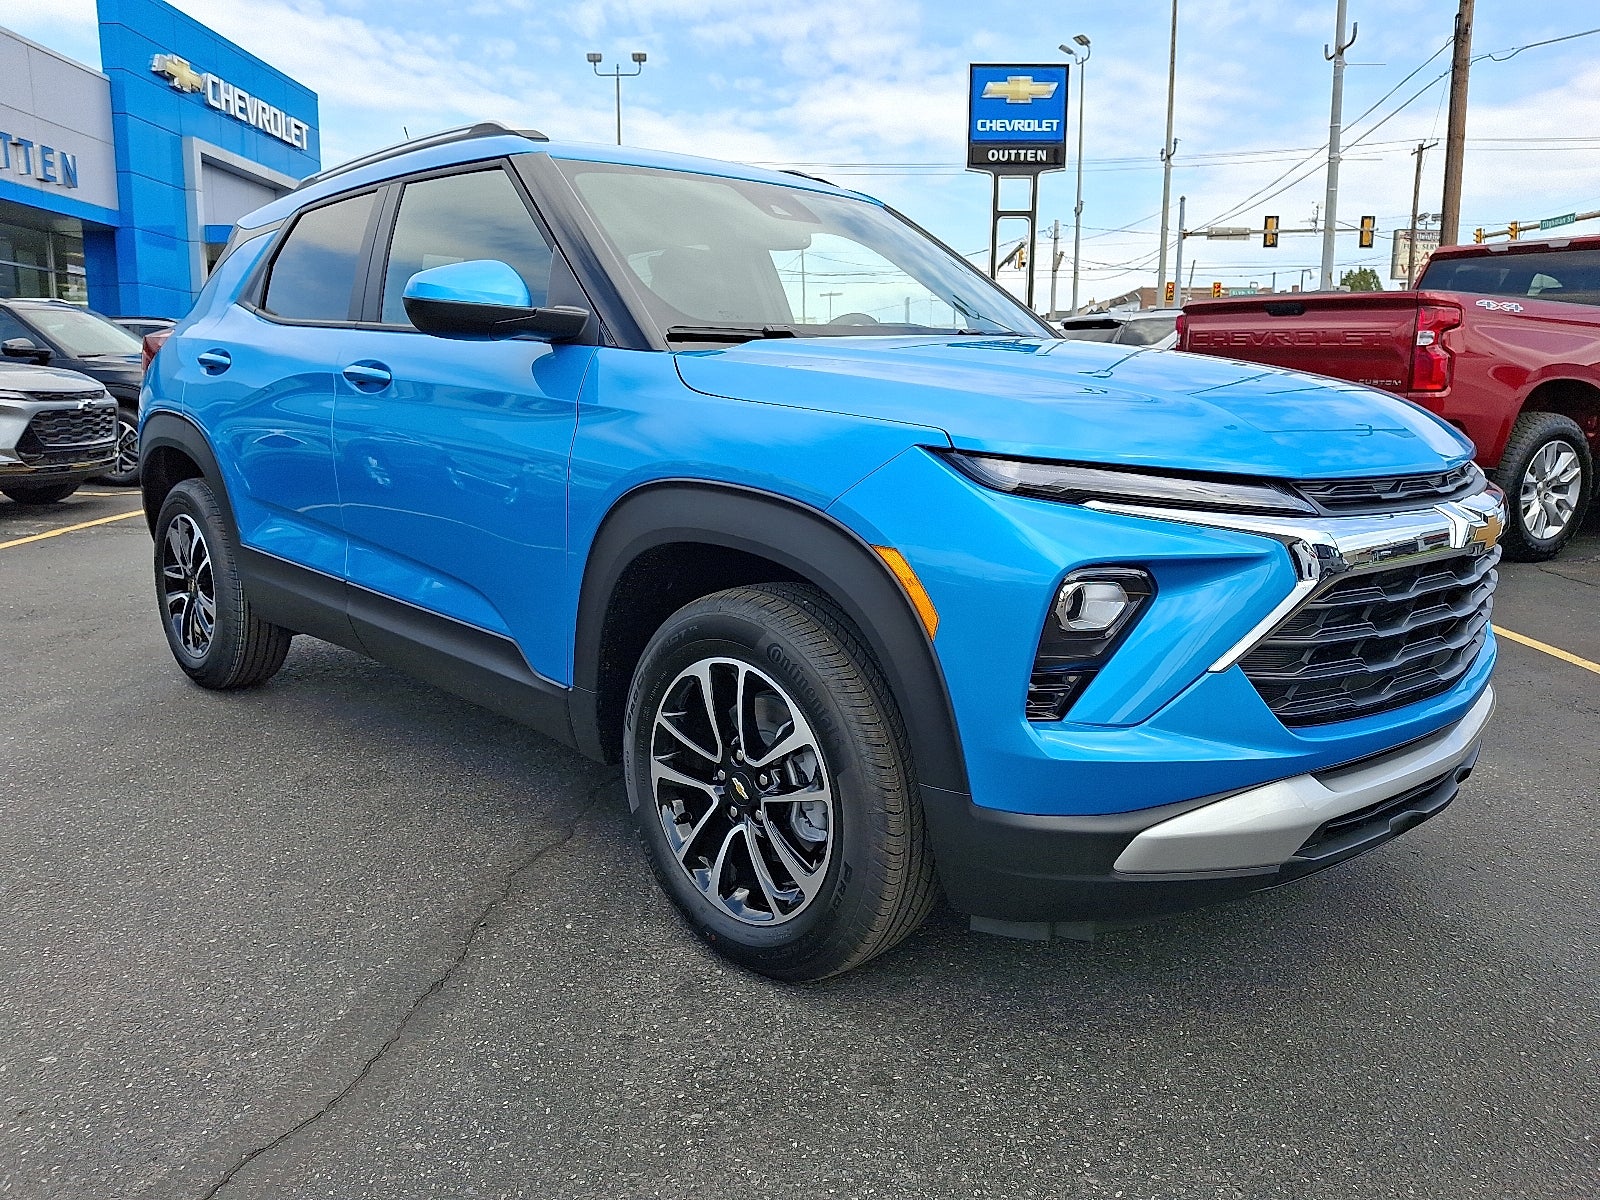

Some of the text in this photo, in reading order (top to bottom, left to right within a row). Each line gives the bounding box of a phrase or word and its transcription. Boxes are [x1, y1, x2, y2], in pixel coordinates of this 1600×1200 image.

[203, 73, 309, 151] CHEVROLET
[977, 120, 1060, 131] CHEVROLET
[987, 149, 1047, 161] OUTTEN
[1191, 330, 1391, 346] CHEVROLET
